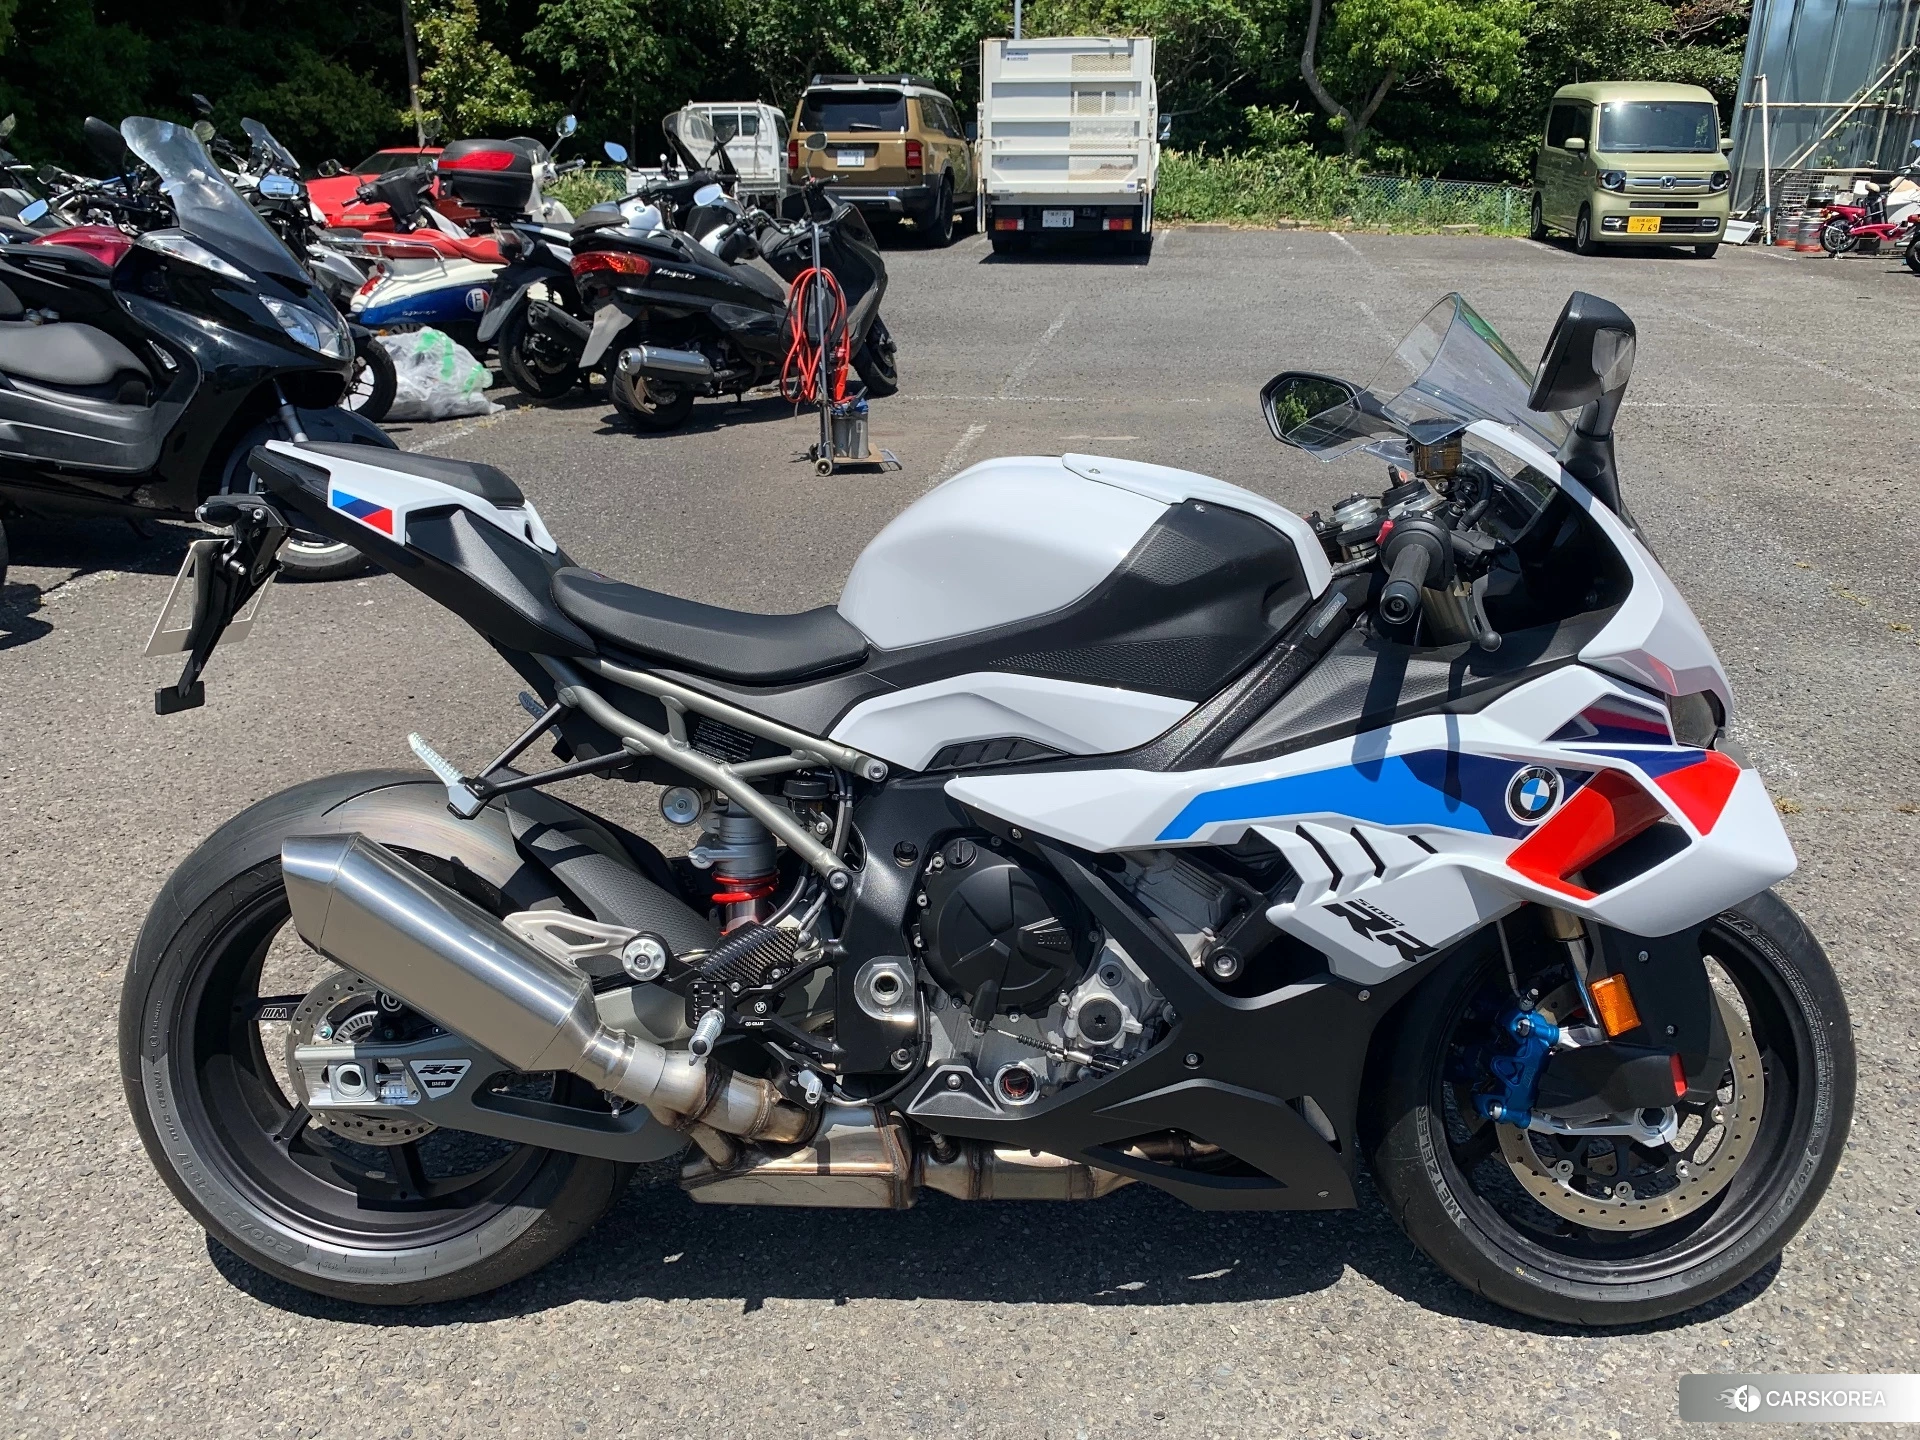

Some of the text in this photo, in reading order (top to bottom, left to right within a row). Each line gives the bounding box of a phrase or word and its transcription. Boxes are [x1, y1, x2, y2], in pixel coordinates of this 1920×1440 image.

[474, 293, 481, 307] F
[1520, 769, 1557, 789] BMW
[1354, 898, 1405, 927] S1000
[1321, 900, 1440, 963] RR
[418, 1064, 465, 1075] RR
[1416, 1105, 1462, 1220] METZELER
